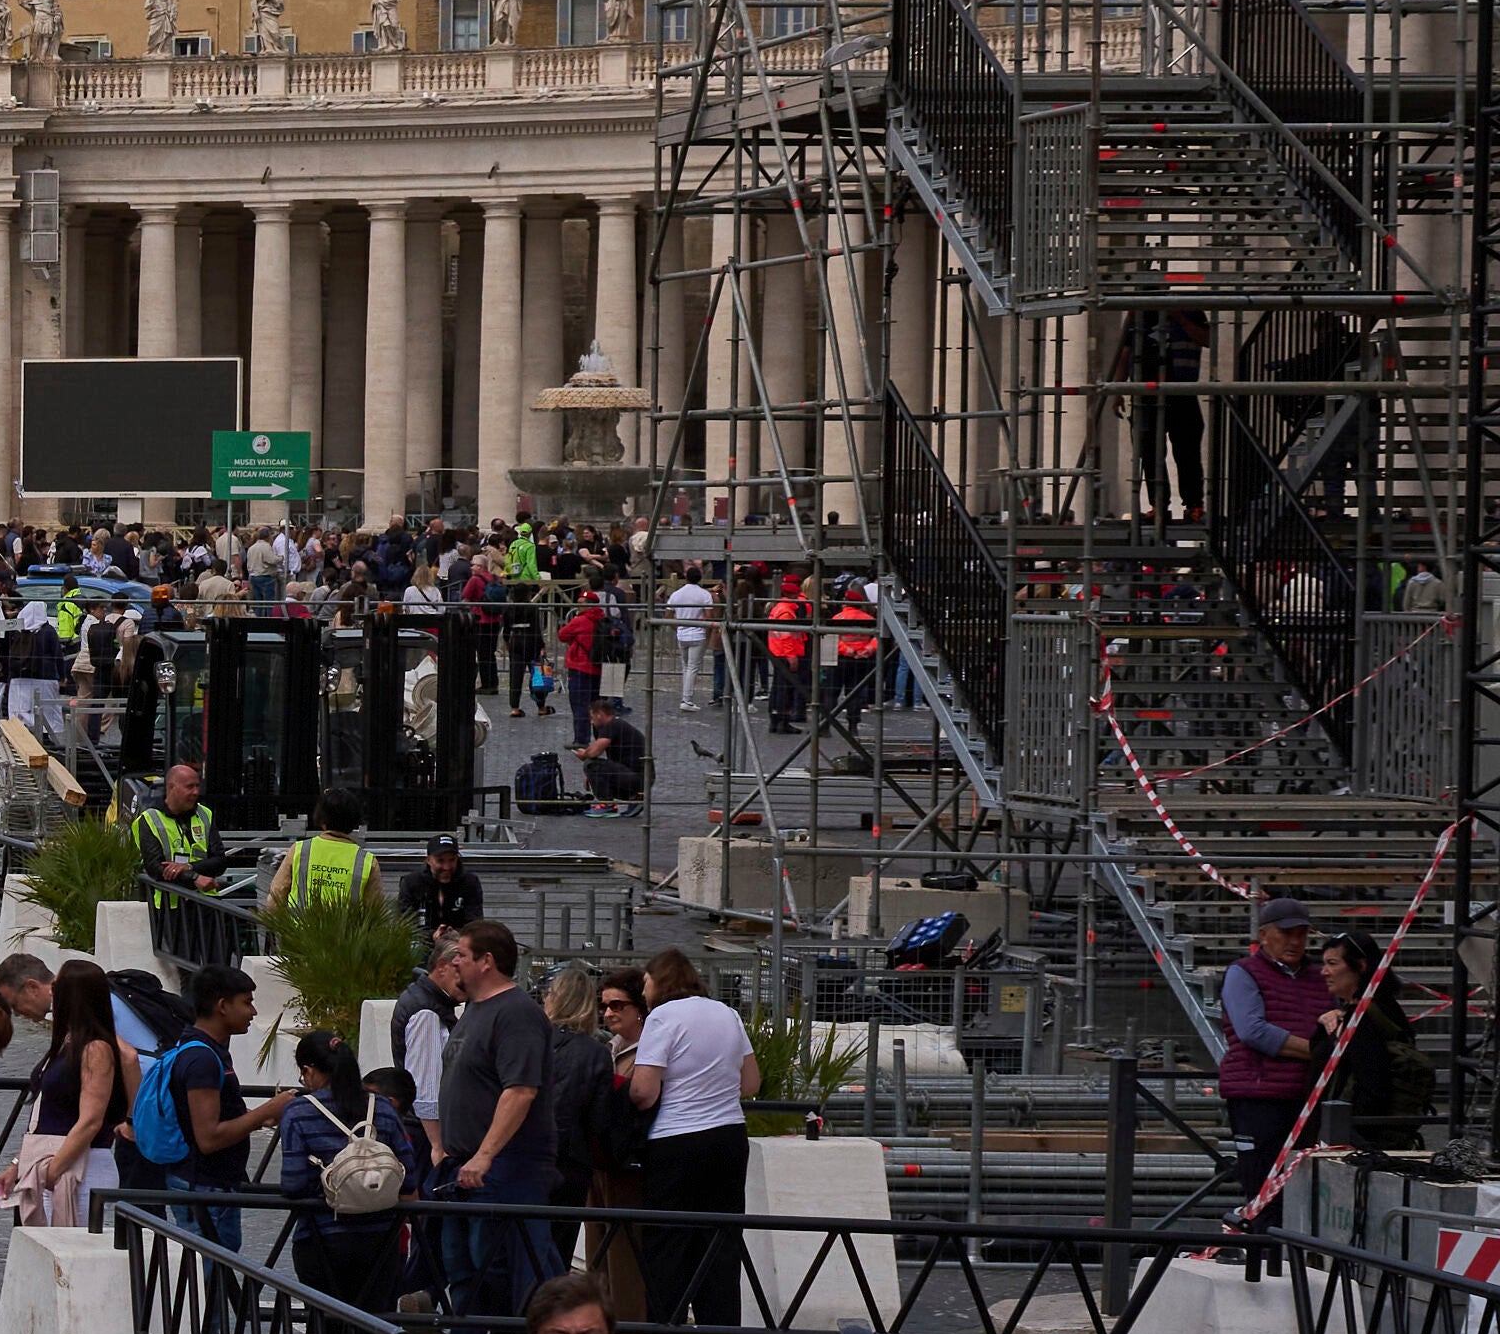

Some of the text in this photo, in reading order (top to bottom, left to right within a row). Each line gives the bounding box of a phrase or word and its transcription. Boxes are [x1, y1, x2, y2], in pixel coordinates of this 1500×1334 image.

[234, 458, 289, 467] MUSEI VATICANI
[228, 470, 294, 479] VATICAN MUSEUMS
[311, 864, 350, 875] SECURITY
